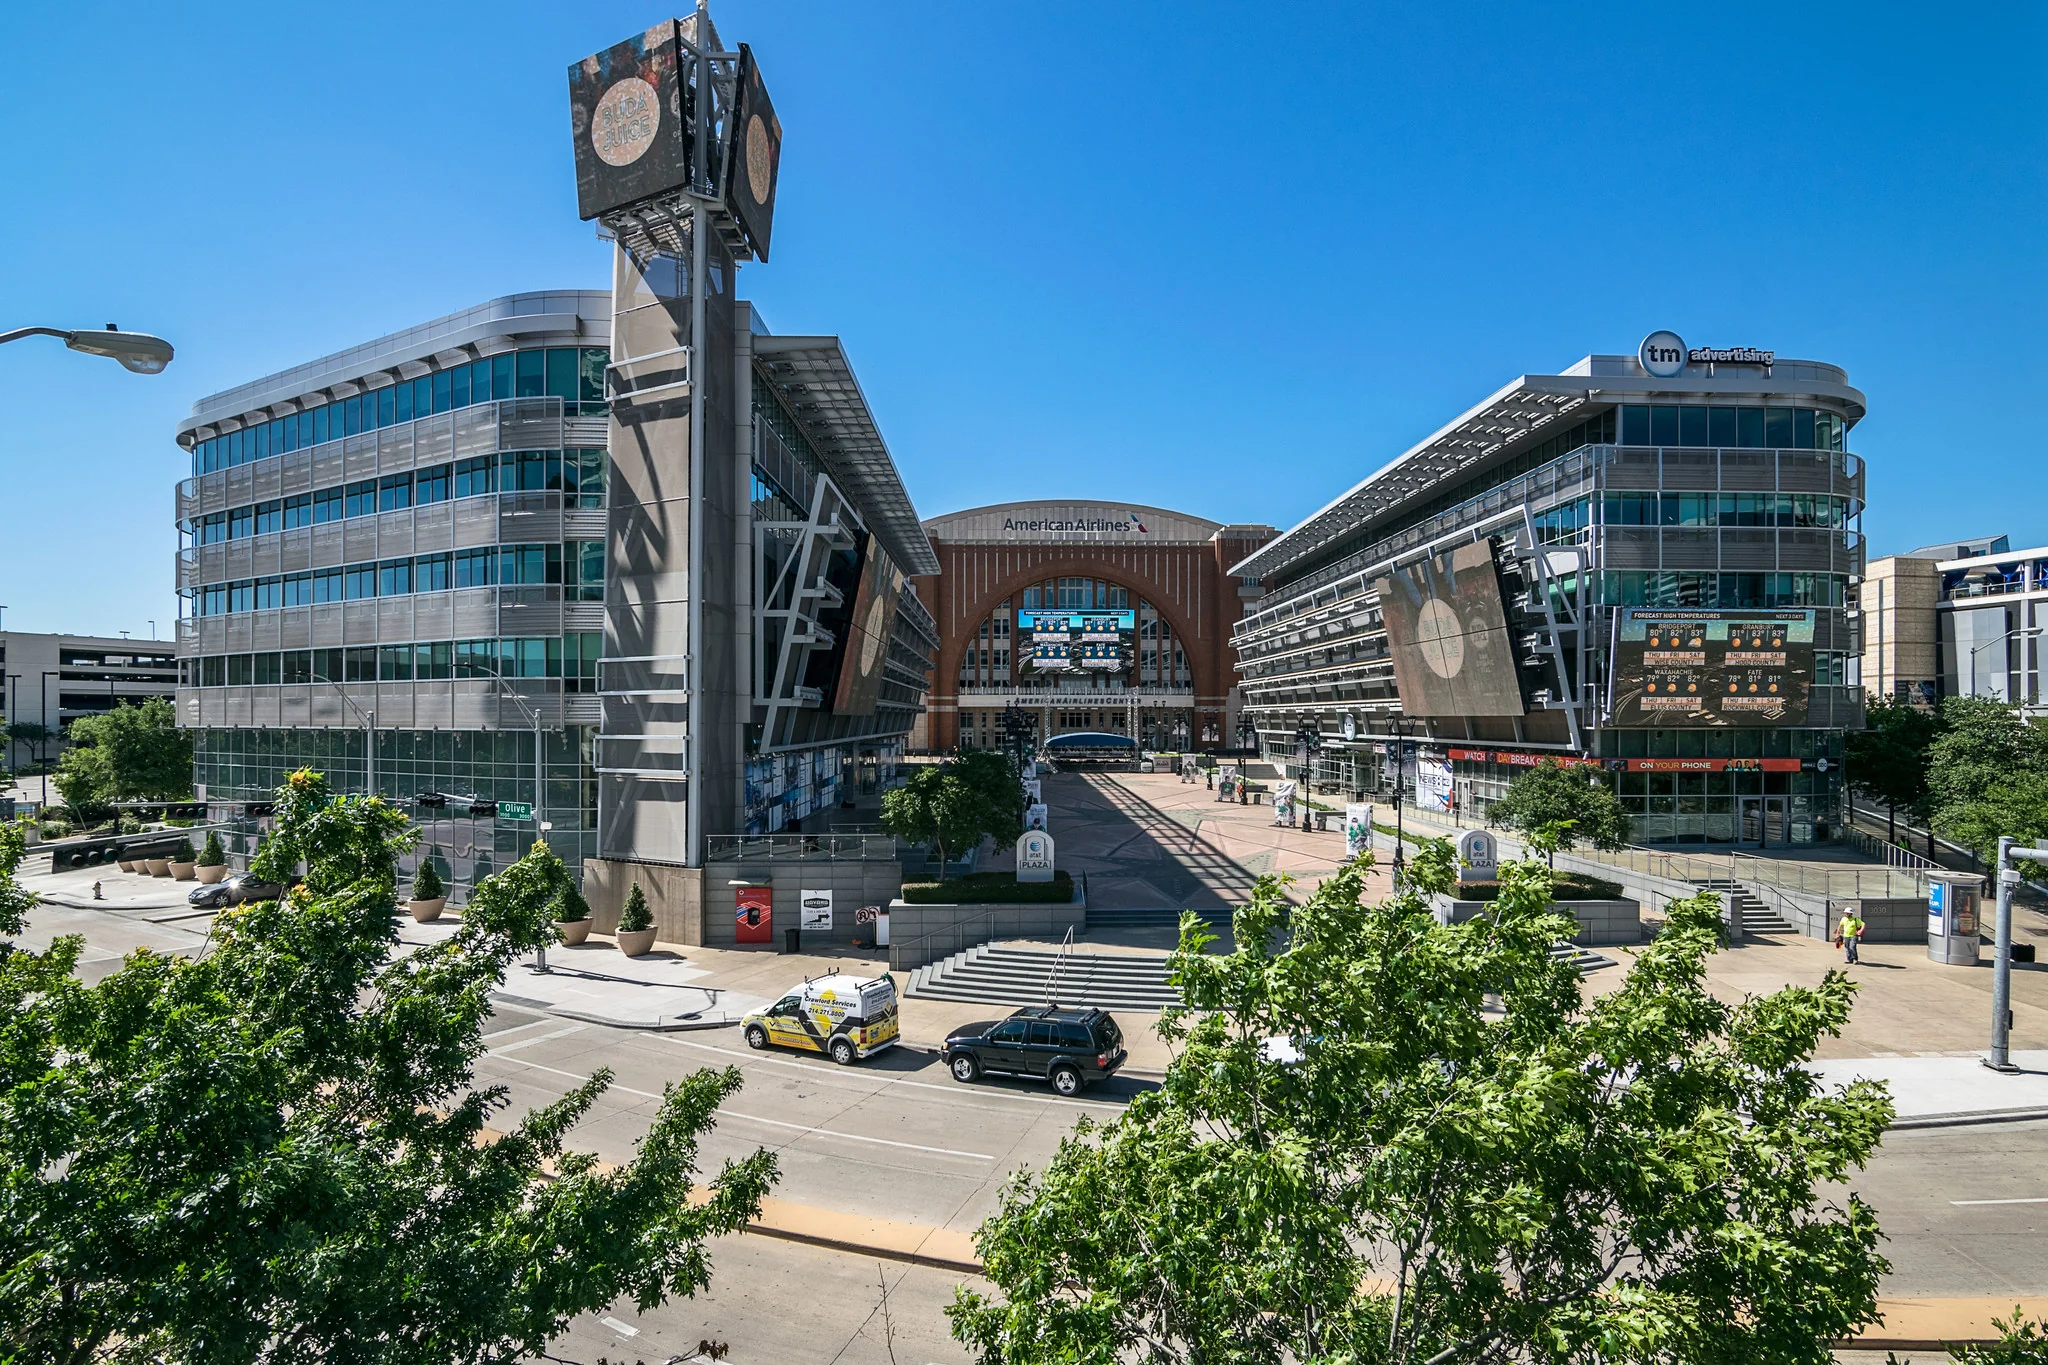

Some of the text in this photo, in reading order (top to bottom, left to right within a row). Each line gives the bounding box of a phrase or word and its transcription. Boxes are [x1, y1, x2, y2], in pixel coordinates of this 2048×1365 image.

[602, 92, 648, 128] BUDA
[603, 115, 651, 151] JUICE
[1648, 345, 1774, 366] tm advertising
[1004, 518, 1131, 532] American Airlines
[1464, 751, 1486, 760] WATCH
[1497, 754, 1536, 766] DAYBREAK
[505, 804, 525, 813] Olive
[804, 996, 830, 1005] Crawford
[831, 999, 857, 1008] Services
